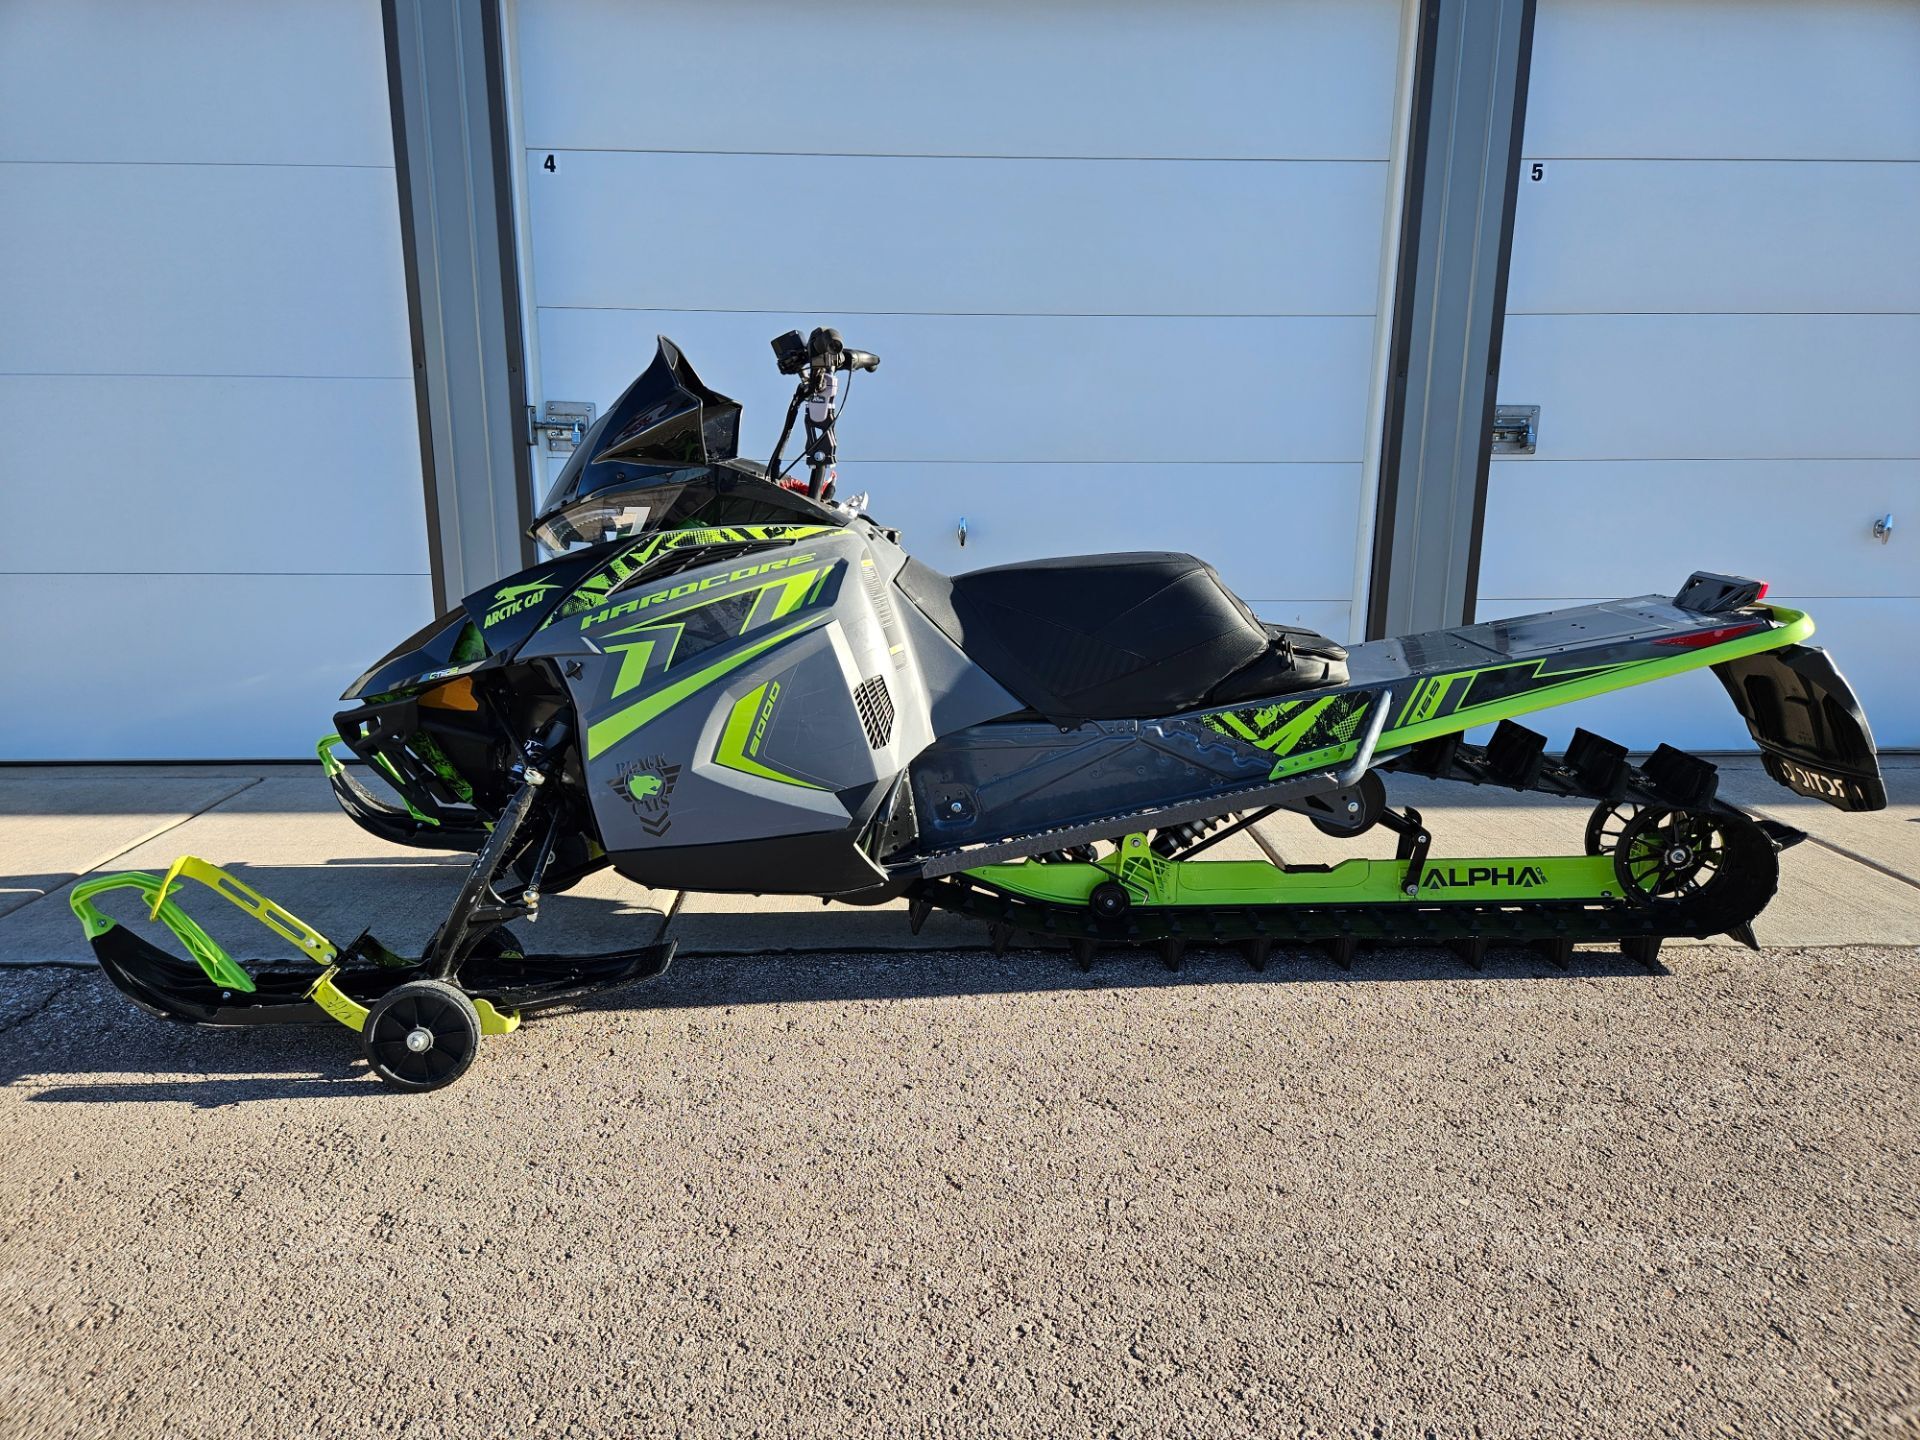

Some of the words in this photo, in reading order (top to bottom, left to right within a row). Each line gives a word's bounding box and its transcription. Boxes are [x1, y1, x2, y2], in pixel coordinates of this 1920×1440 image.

[544, 154, 556, 173] 4
[1531, 163, 1543, 182] 5
[580, 552, 817, 631] HARDCORE
[483, 598, 523, 629] ARCTIC
[524, 588, 546, 608] CAT
[1416, 679, 1441, 719] 165
[749, 681, 781, 757] 8000
[615, 752, 669, 778] BLACK
[632, 795, 670, 816] CATS
[1421, 866, 1542, 890] ALPHA
